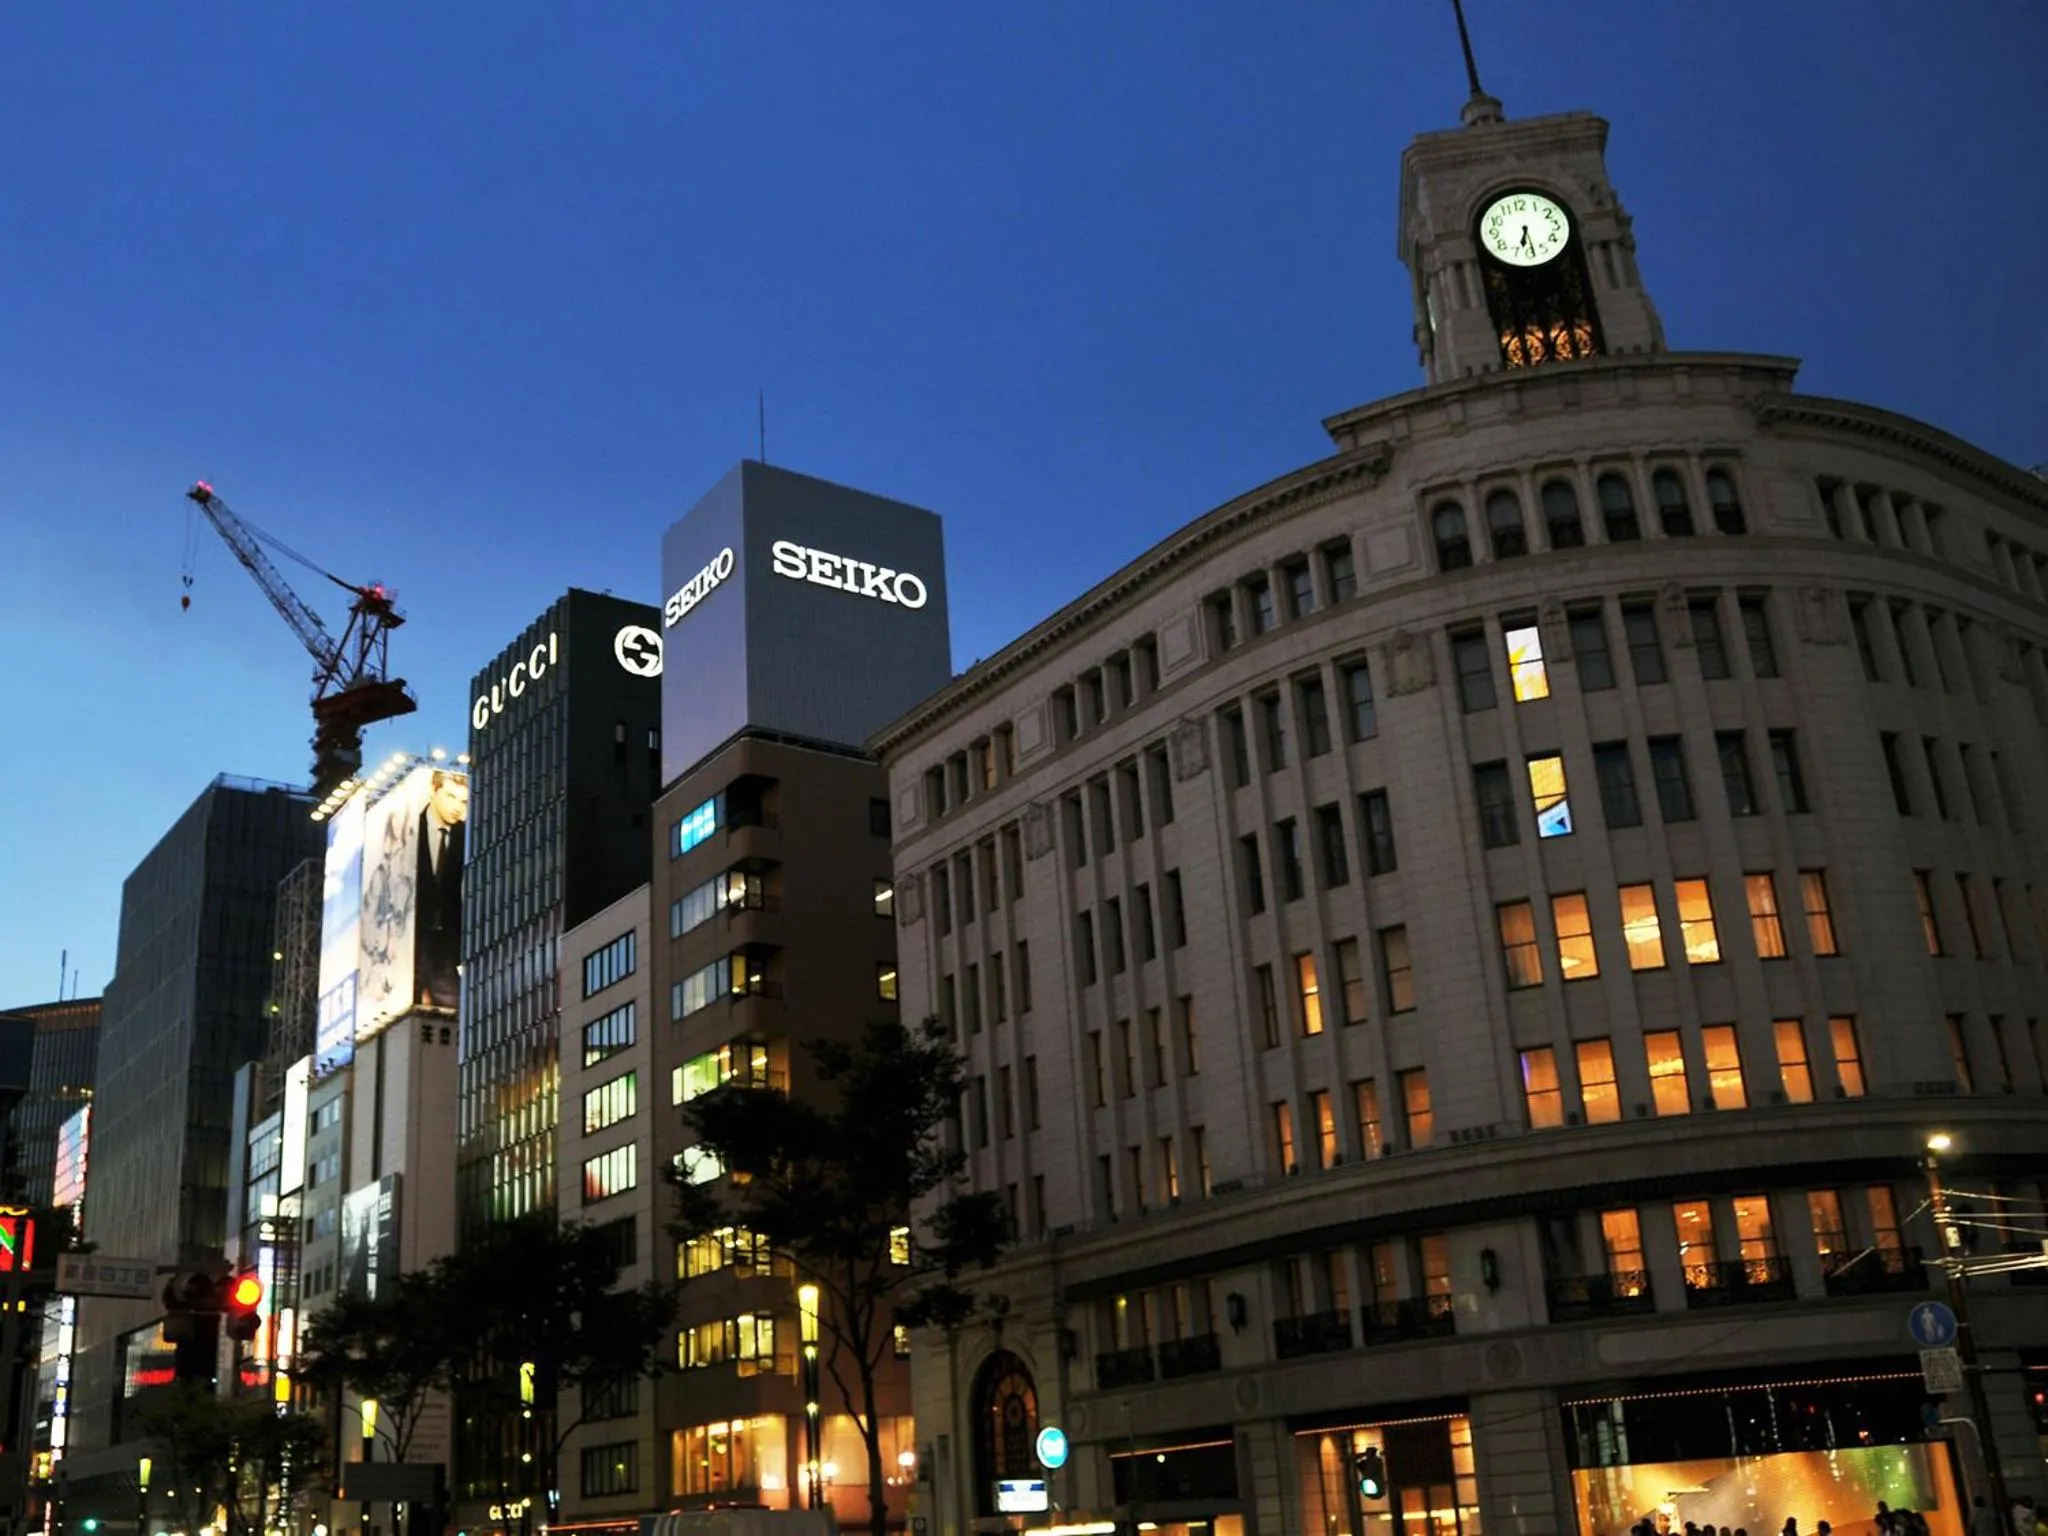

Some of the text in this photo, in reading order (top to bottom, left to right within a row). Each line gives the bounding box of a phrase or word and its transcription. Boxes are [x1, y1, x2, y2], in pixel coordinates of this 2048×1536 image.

[1501, 204, 1511, 216] 11
[1514, 199, 1526, 211] 12
[1533, 201, 1537, 212] 1
[1543, 207, 1552, 219] 2
[1491, 216, 1503, 227] 10
[1551, 220, 1561, 231] 3
[1489, 228, 1500, 239] 9
[1548, 233, 1557, 243] 4
[1497, 240, 1508, 251] 8
[1511, 246, 1520, 257] 7
[1539, 243, 1549, 255] 5
[1525, 247, 1535, 259] 6
[771, 540, 928, 609] SEIKO
[665, 547, 734, 628] SEIKO
[473, 633, 557, 730] GUCCI
